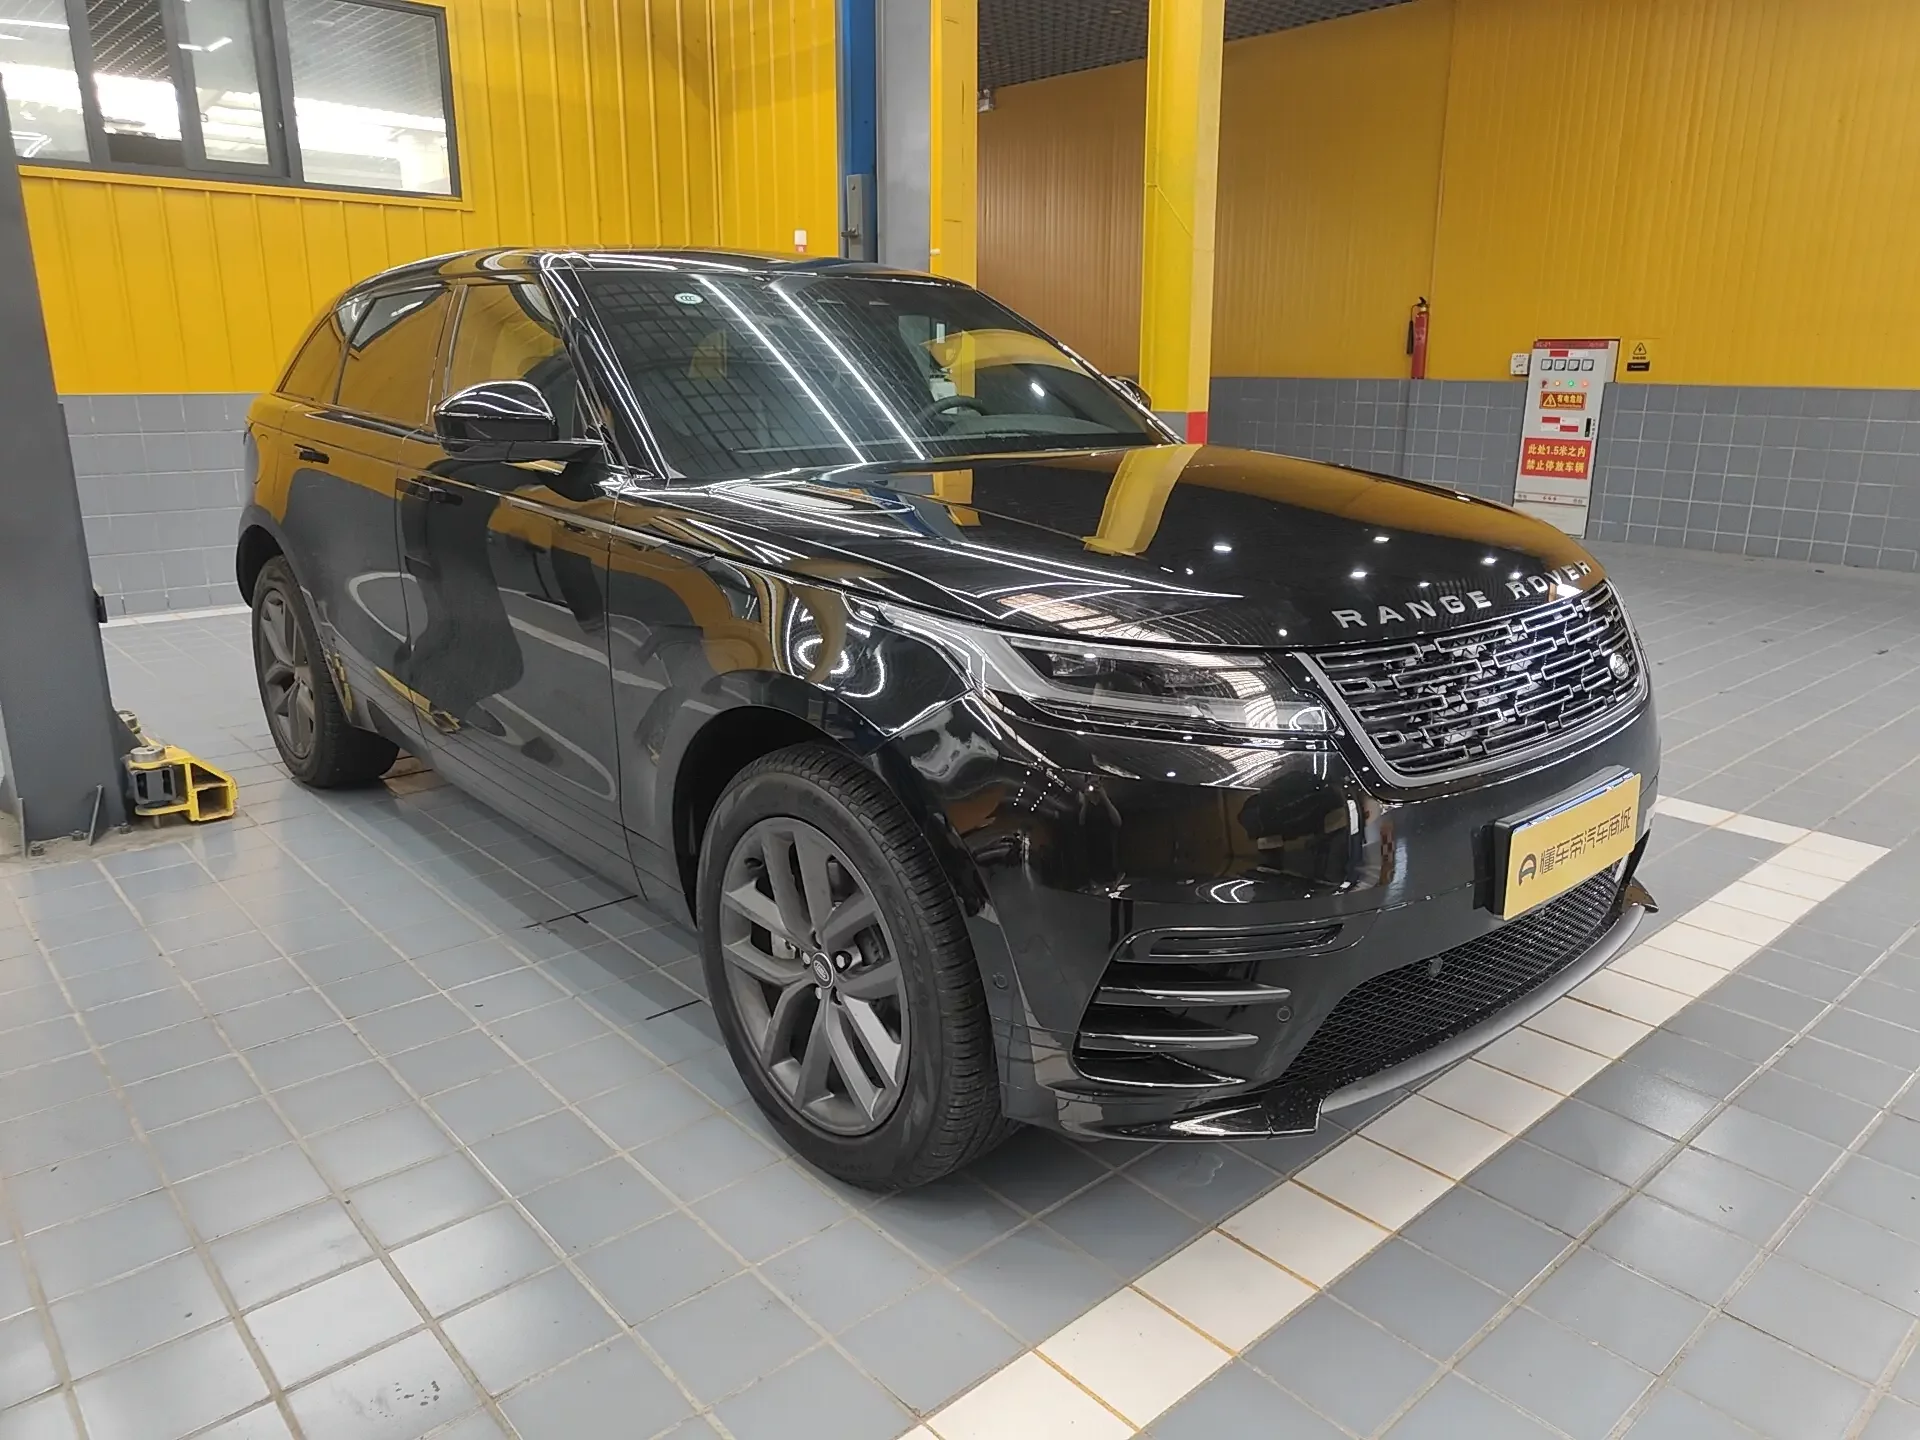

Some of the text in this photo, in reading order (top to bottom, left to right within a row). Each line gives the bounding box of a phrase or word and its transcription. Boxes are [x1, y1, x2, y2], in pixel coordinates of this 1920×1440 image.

[1527, 443, 1586, 458] 此处1.5米之内
[1526, 458, 1585, 473] 禁止停放车辆
[1331, 560, 1592, 629] RANGE ROVER
